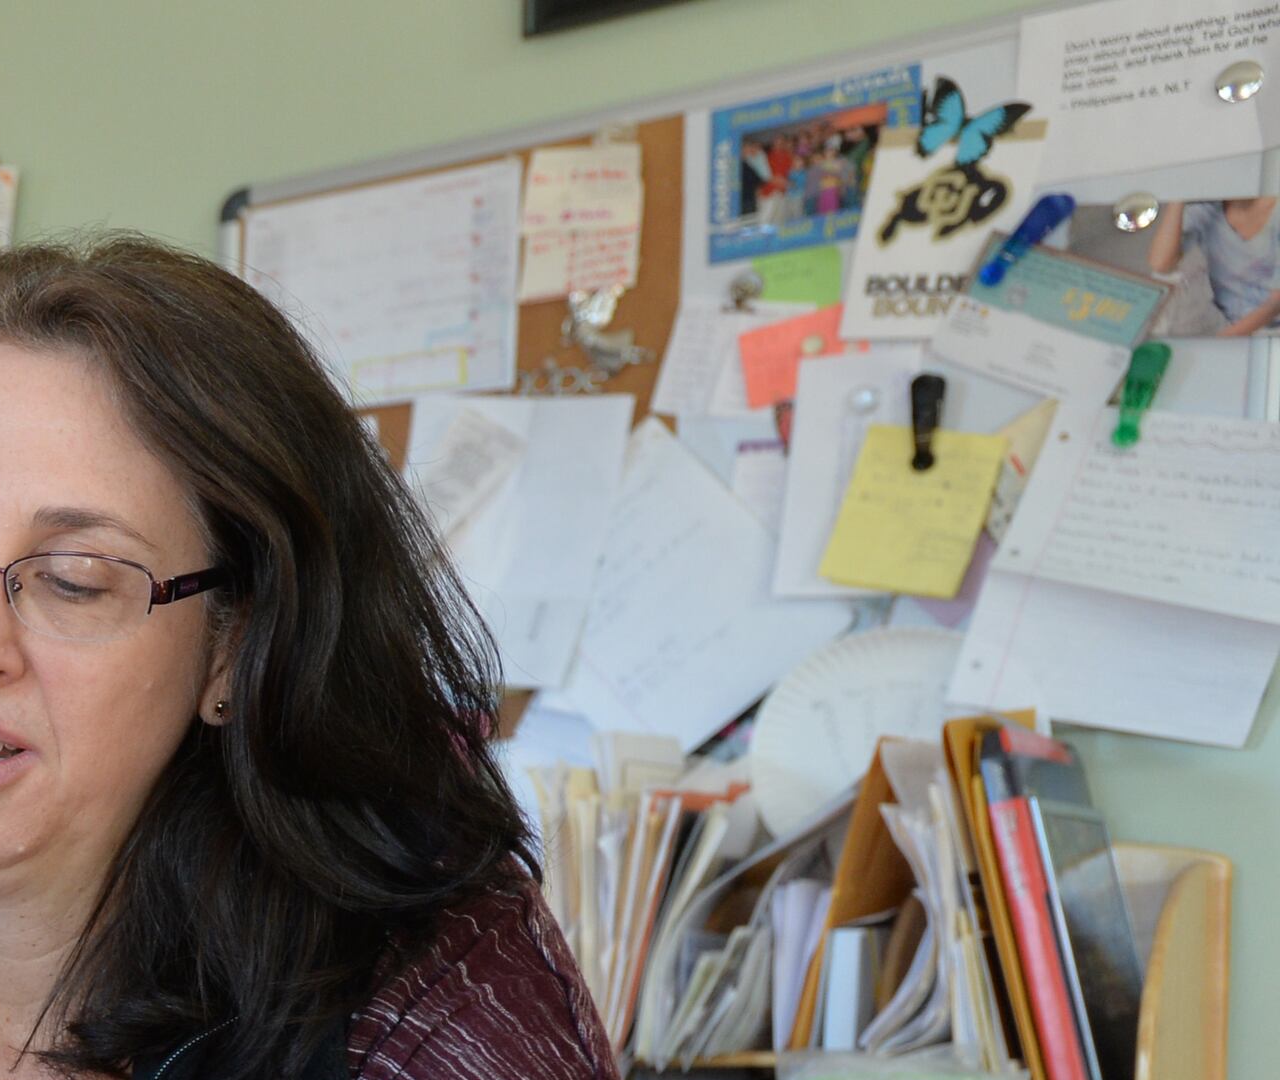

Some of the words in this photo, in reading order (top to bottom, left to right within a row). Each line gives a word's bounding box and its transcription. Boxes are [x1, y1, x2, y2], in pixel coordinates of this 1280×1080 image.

[1135, 25, 1170, 41] about
[864, 274, 971, 297] BOULDE
[871, 296, 955, 320] BOUN
